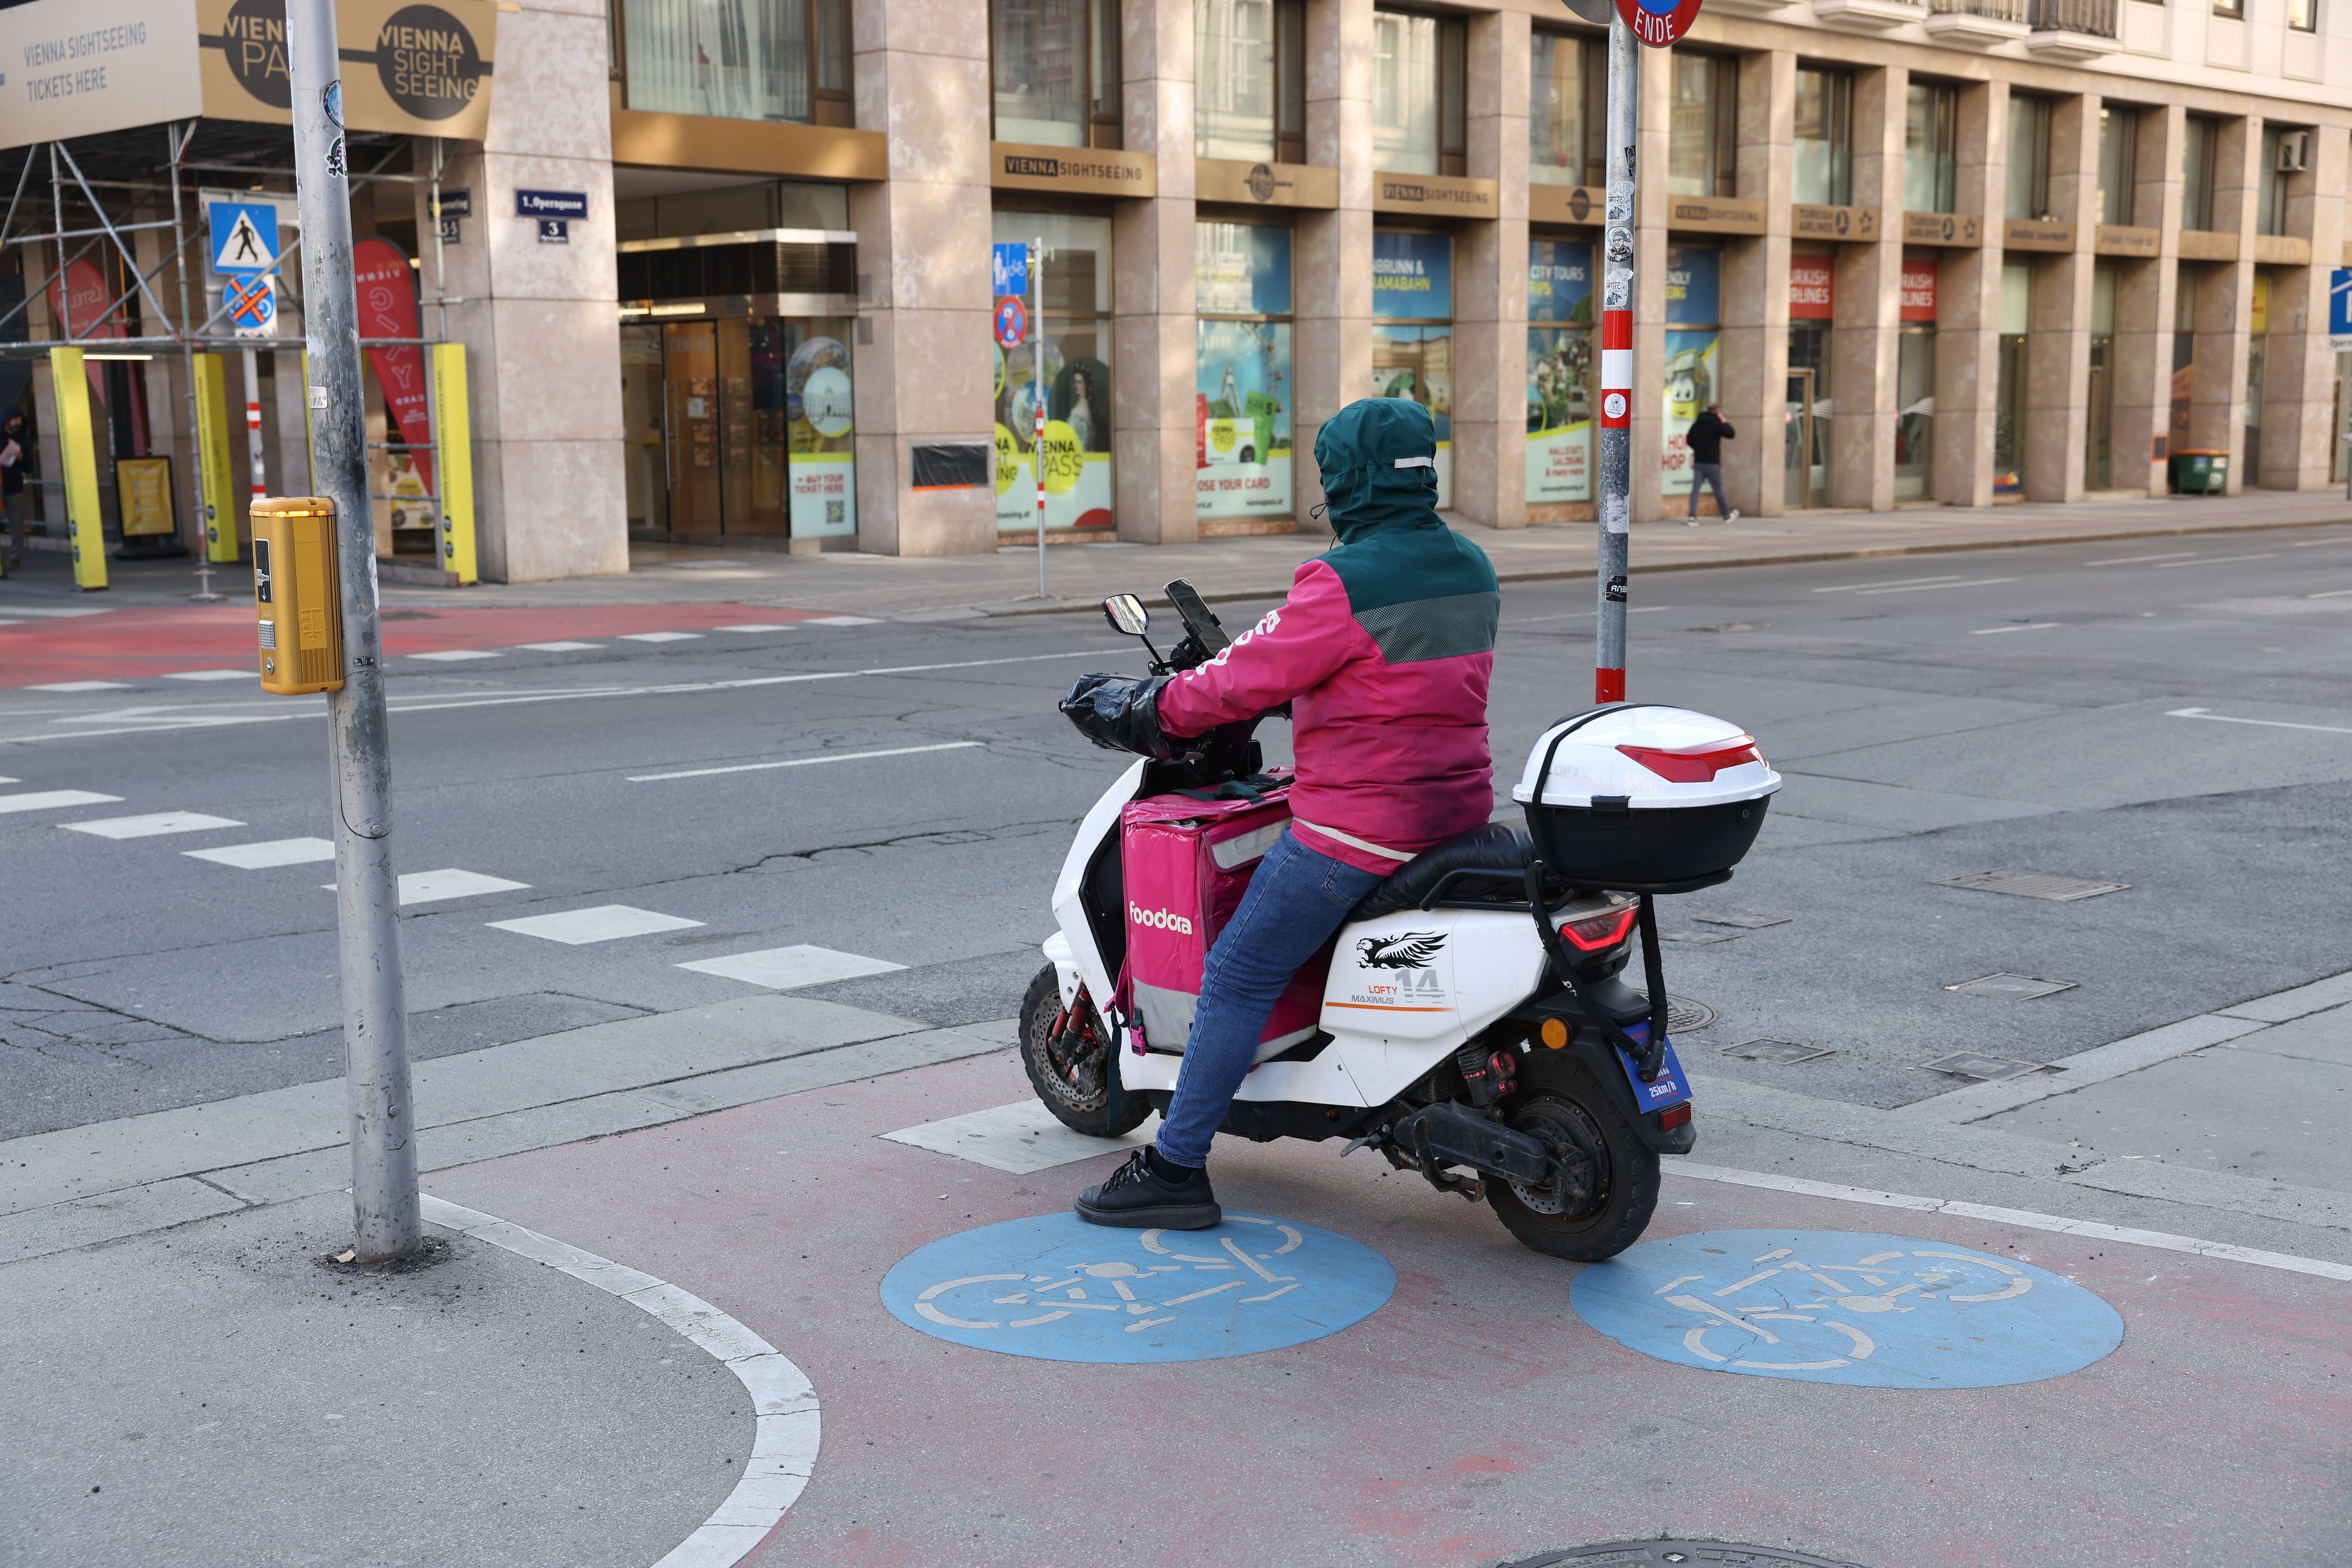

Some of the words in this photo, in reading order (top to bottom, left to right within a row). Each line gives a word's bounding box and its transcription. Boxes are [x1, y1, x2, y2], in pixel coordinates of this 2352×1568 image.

[224, 15, 288, 42] VIEN
[1634, 6, 1675, 43] ENDE
[24, 39, 67, 68] VIENNA
[68, 22, 146, 59] SIGHTSEEING
[379, 25, 465, 55] VIENNA
[242, 41, 290, 81] PA
[395, 49, 460, 76] SIGHT
[27, 74, 73, 102] TICKETS
[76, 66, 107, 93] HERE
[395, 72, 477, 101] SEEING
[1006, 158, 1057, 176] VIENNA
[1060, 162, 1142, 180] SIGHTSEEING
[1384, 185, 1423, 200] VIENNA
[1424, 188, 1488, 203] SIGHTSEEING
[1799, 209, 1833, 220] TURKISH
[548, 222, 559, 236] 3
[1798, 222, 1833, 232] AIRLINES
[1415, 259, 1424, 275] &
[1530, 265, 1552, 279] CITY
[1553, 266, 1585, 281] TOURS
[1661, 453, 1685, 470] HOP
[806, 474, 821, 483] BUY
[824, 474, 844, 482] YOUR
[1197, 479, 1215, 492] OSE
[1218, 479, 1243, 490] YOUR
[1245, 477, 1271, 490] CARD
[795, 484, 822, 494] TICKET
[824, 484, 844, 493] HERE
[1129, 900, 1193, 935] foodora
[1368, 985, 1398, 995] LOFTY
[1395, 969, 1445, 1004] 14
[1351, 994, 1395, 1004] MAXIMUS
[1649, 1081, 1677, 1098] 25km/h
